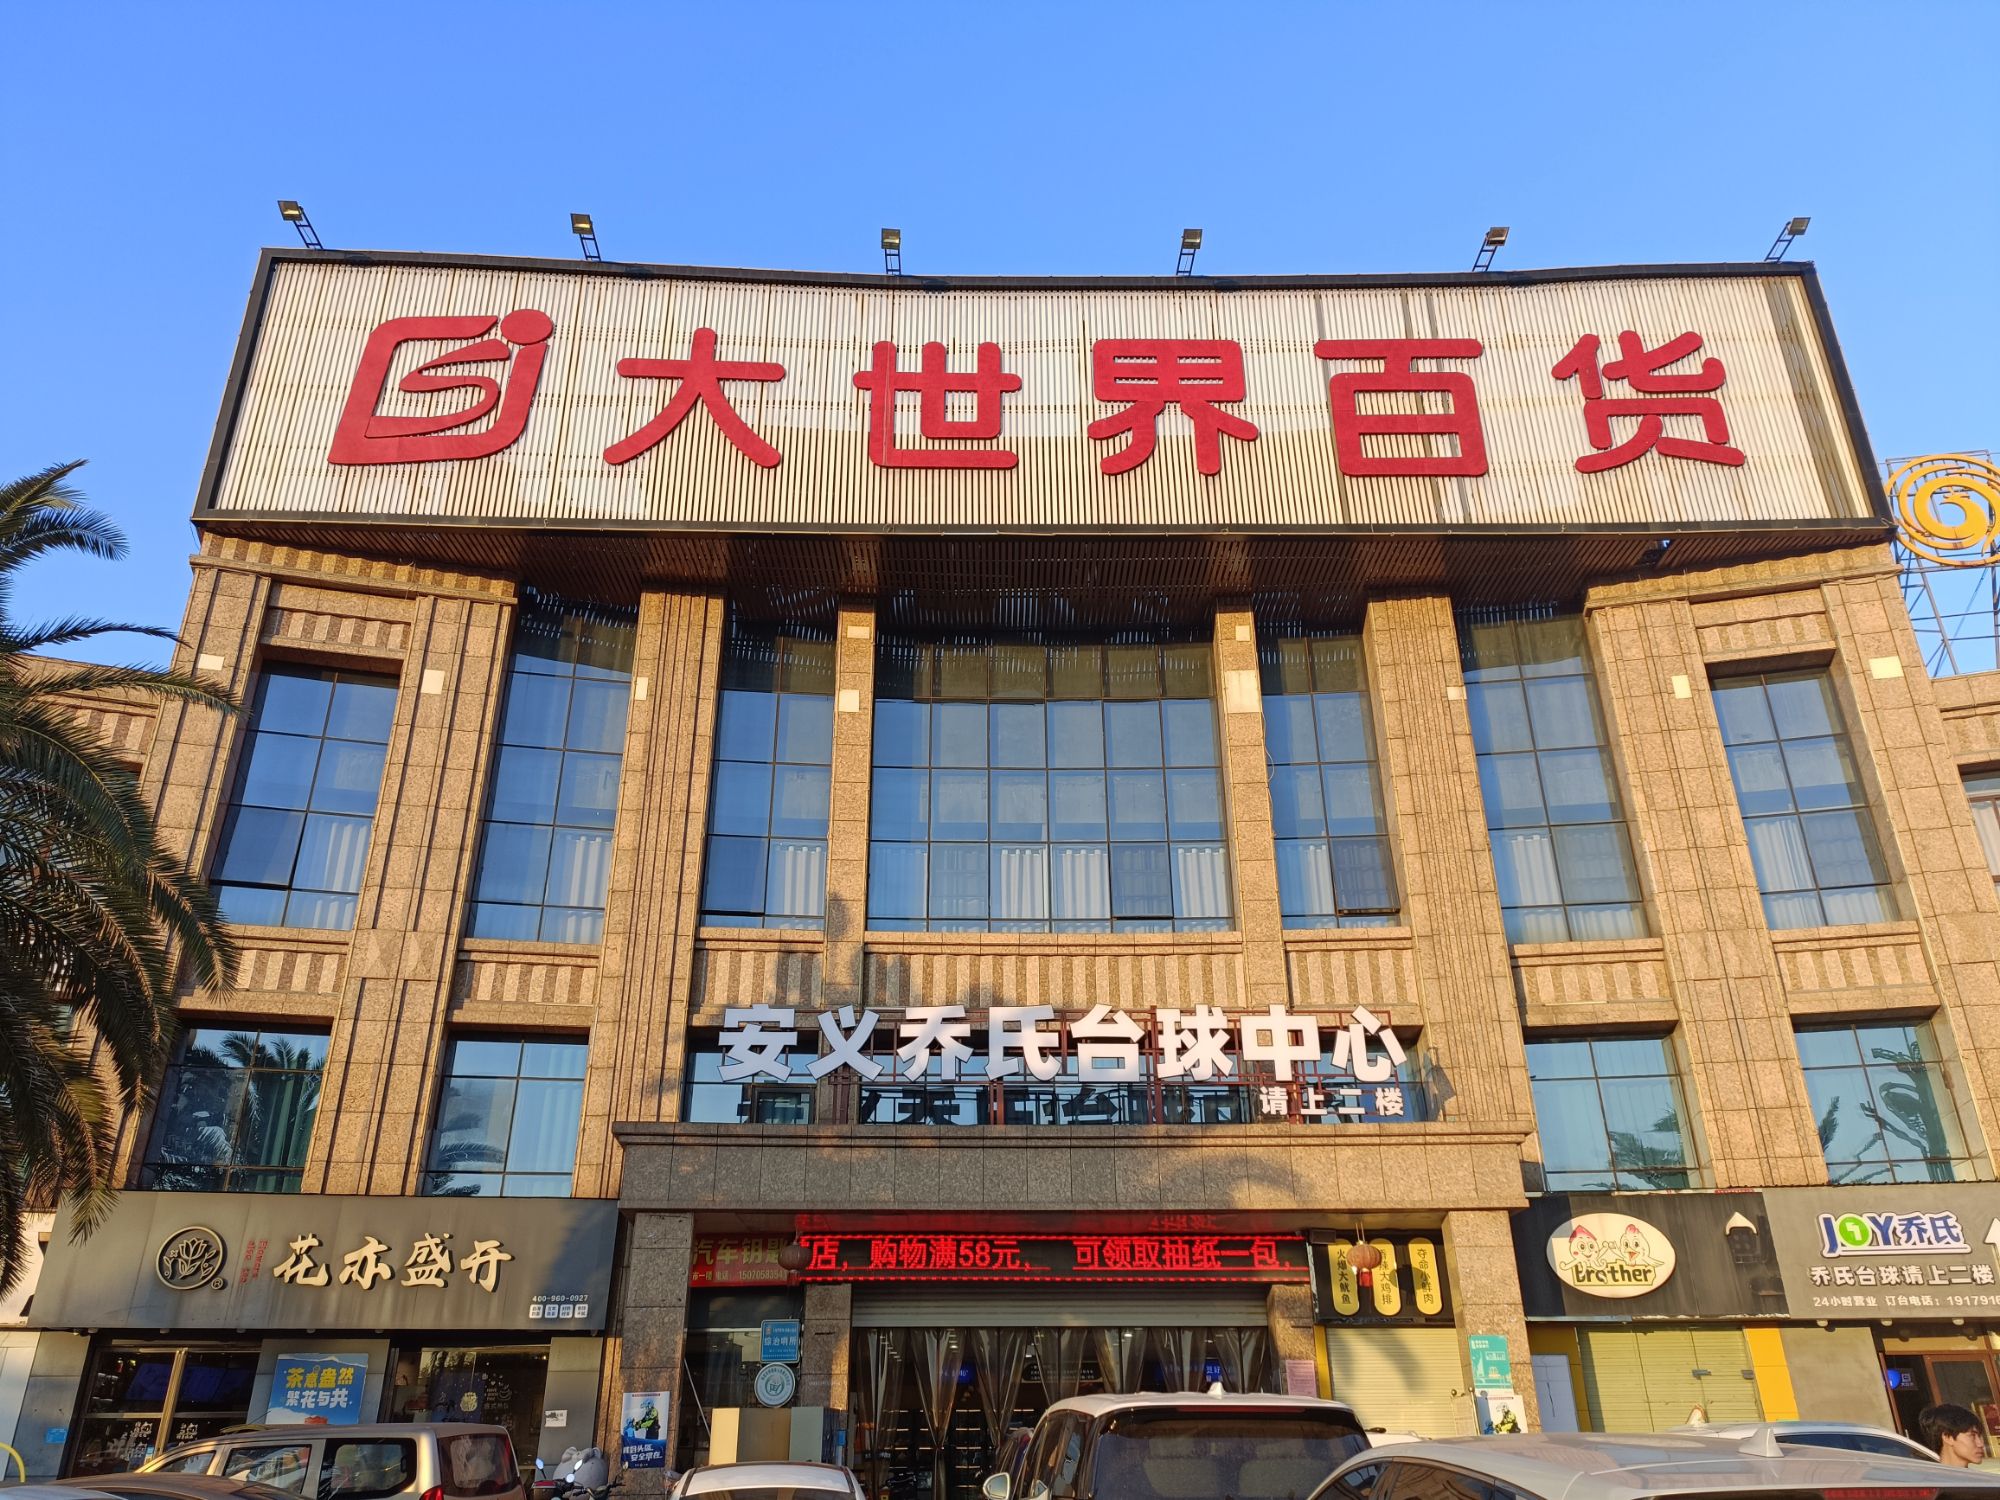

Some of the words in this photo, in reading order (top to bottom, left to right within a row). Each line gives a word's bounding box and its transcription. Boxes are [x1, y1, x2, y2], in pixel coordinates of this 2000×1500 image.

[603, 327, 1745, 478] 大世界百货
[717, 1003, 1409, 1083] 安义乔氏台球中心
[1259, 1085, 1404, 1117] 请上二楼
[272, 1232, 512, 1293] 花亦盛开
[1336, 1248, 1352, 1305] 火爆大鱿鱼
[1416, 1248, 1435, 1305] 夺命小鲜肉
[1810, 1264, 1996, 1287] 乔氏台球请上二楼
[532, 1294, 589, 1302] 400-960-0927
[1813, 1295, 1878, 1308] 24小时营业
[1885, 1294, 1940, 1307] 订台电话：
